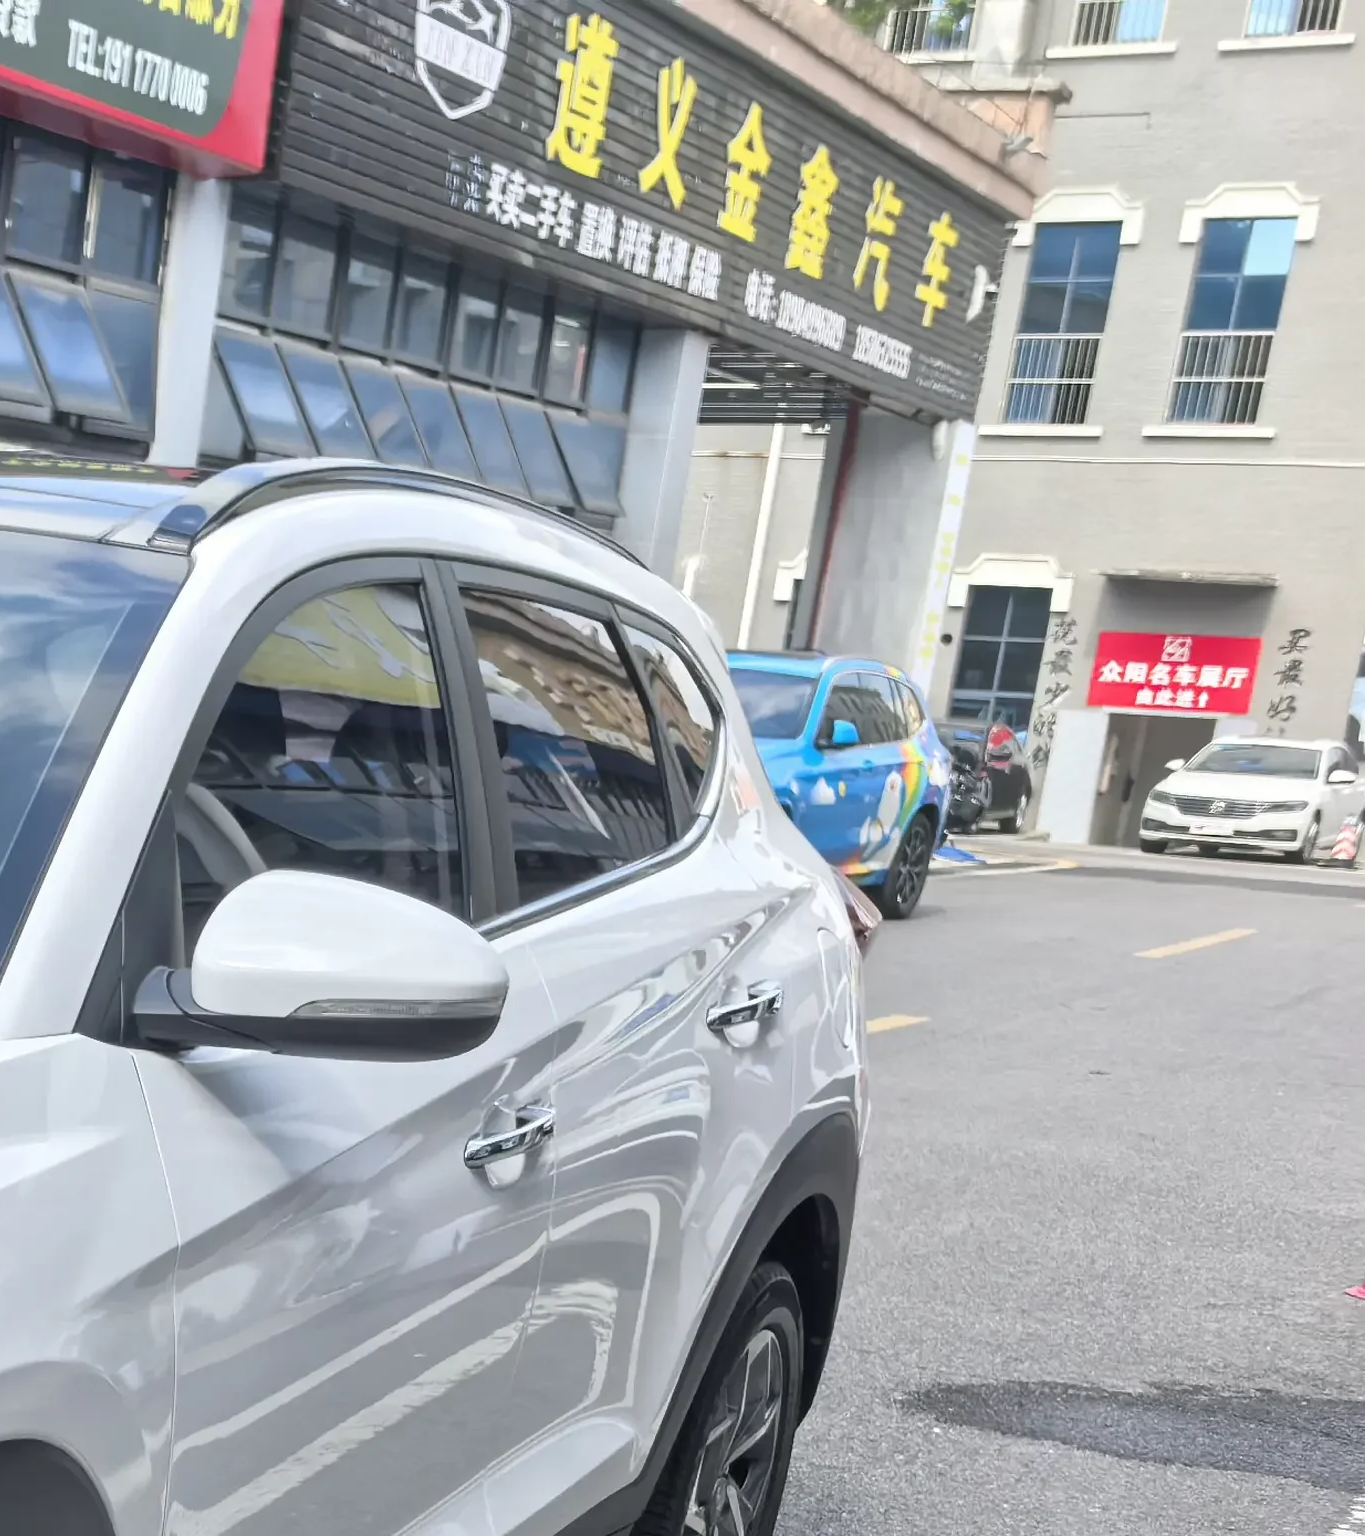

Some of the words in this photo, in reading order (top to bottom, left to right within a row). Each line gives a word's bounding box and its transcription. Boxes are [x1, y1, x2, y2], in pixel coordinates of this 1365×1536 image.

[545, 12, 961, 328] 遵义金鑫汽车
[1097, 659, 1250, 689] 众阳名车展厅
